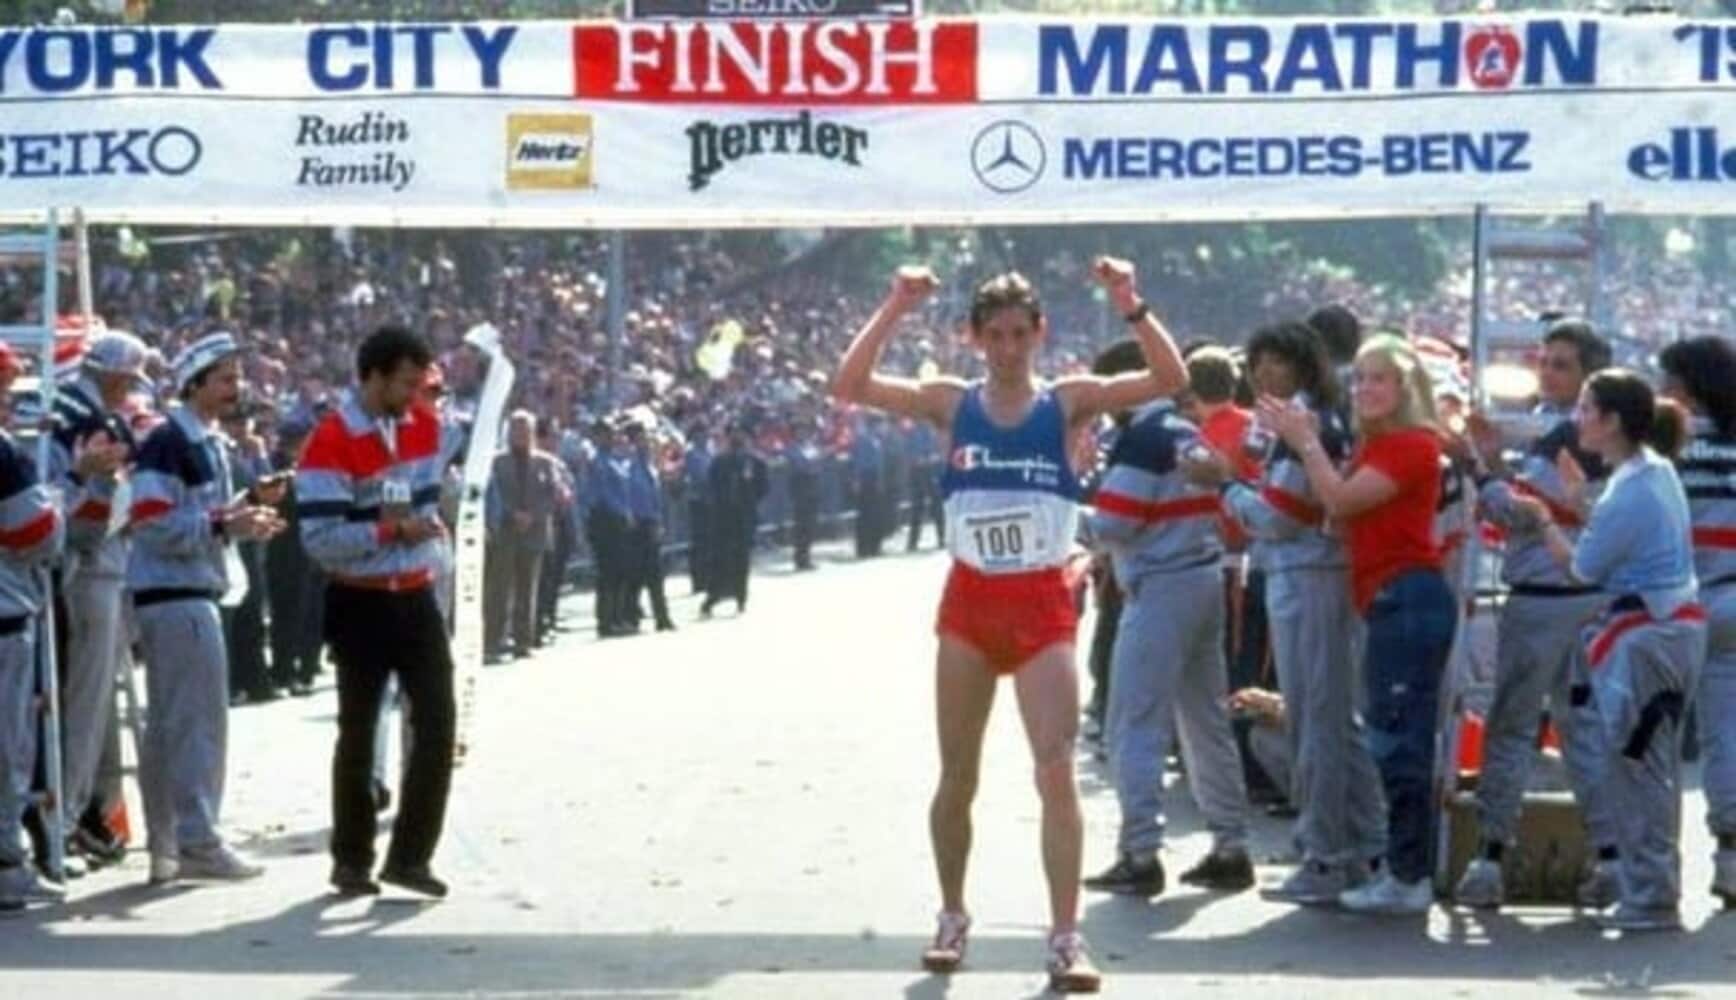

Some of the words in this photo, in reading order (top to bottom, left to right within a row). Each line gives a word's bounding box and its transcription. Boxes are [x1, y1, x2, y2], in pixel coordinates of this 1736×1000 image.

[306, 26, 518, 90] CITY
[613, 18, 940, 95] FINISH
[1673, 24, 1736, 82] 1
[0, 126, 201, 177] EIKO
[296, 111, 409, 145] Rudin
[516, 140, 583, 161] Hertz
[296, 151, 416, 192] Family
[1063, 131, 1530, 179] MERCEDES-BENZ
[973, 523, 1023, 557] 100
